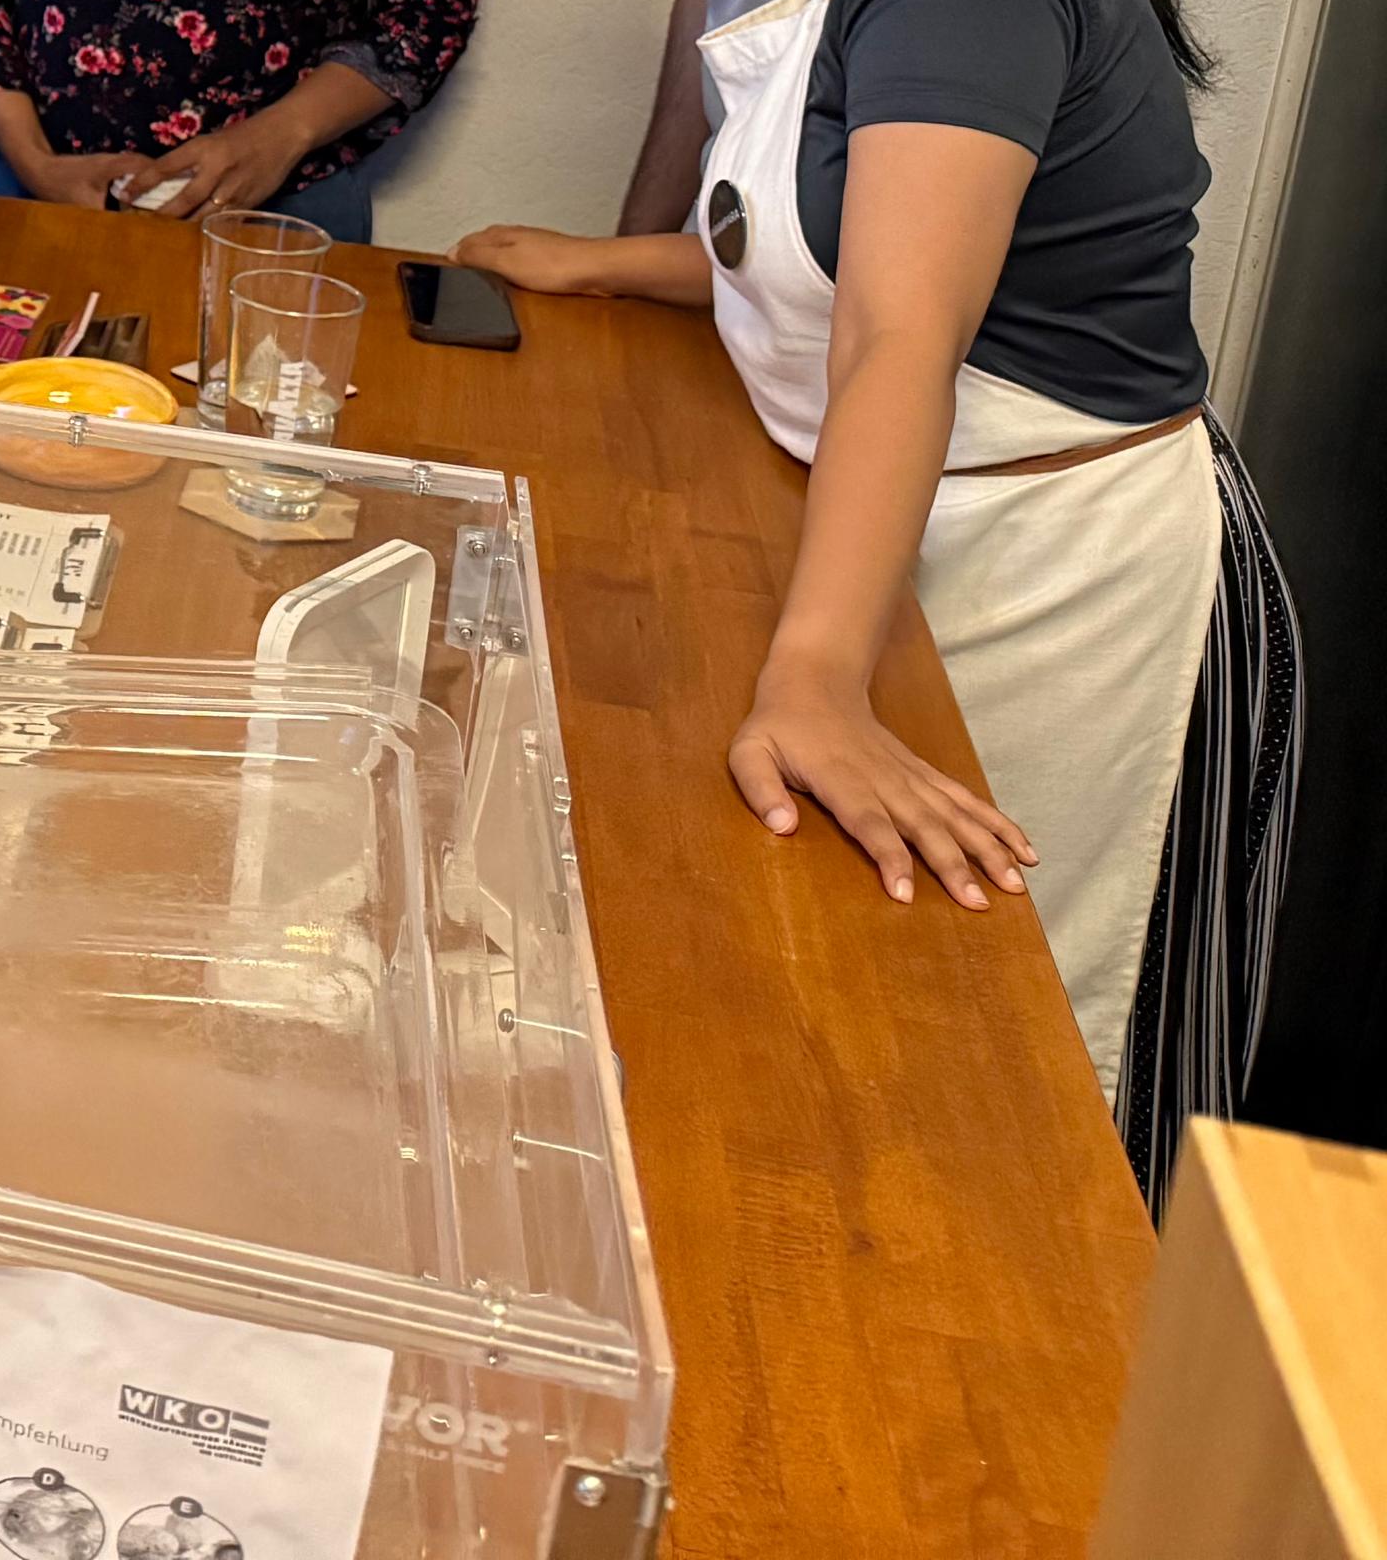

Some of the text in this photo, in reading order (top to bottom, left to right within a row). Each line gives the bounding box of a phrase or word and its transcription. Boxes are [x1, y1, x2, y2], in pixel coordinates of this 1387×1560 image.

[124, 1387, 226, 1431] WKO
[42, 1473, 55, 1485] D
[180, 1501, 193, 1513] E
